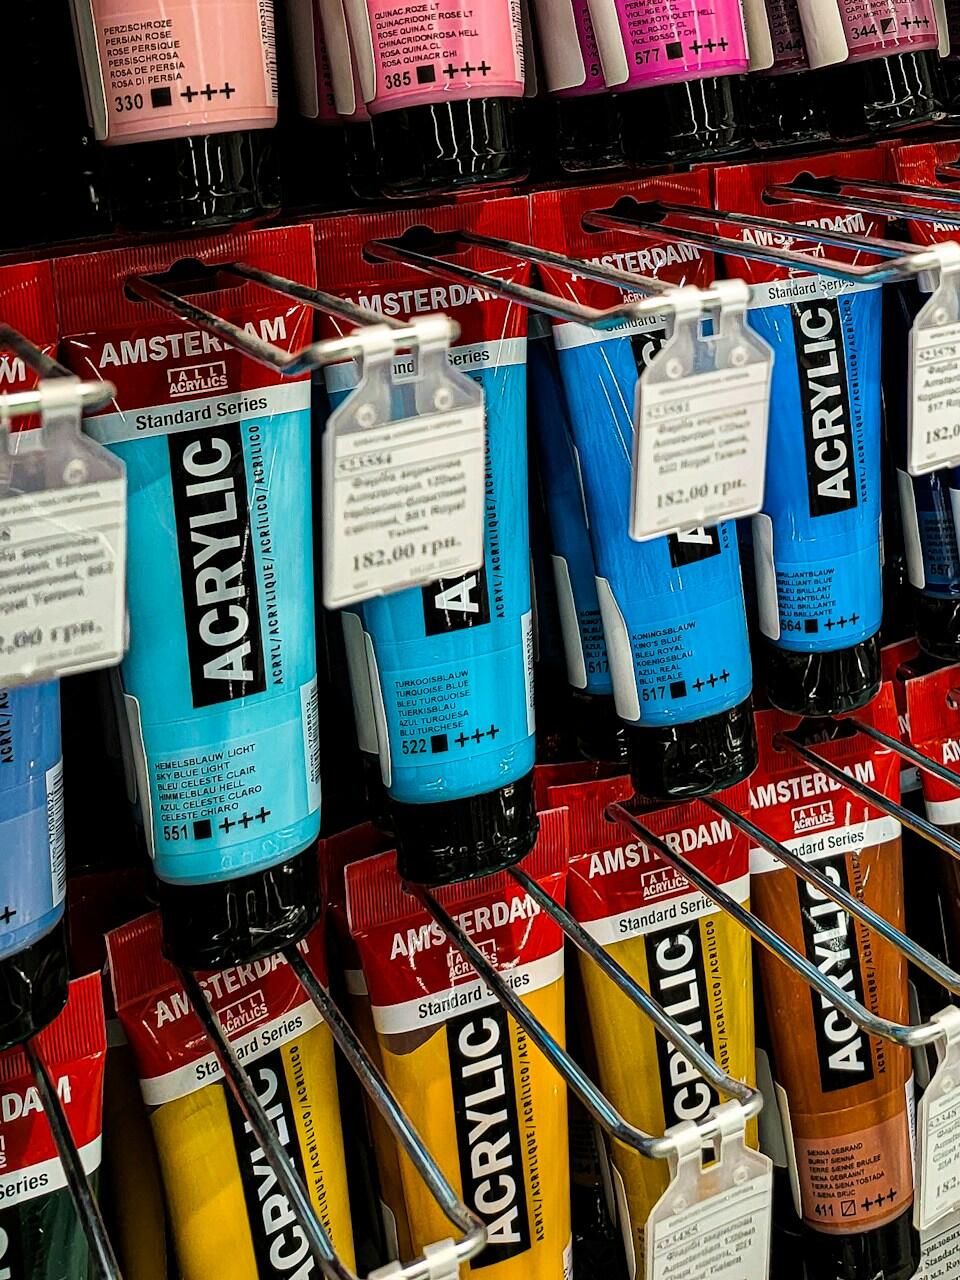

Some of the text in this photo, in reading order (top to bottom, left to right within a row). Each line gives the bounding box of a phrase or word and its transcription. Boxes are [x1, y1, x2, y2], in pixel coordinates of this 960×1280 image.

[376, 14, 436, 30] QUINACRIDONE
[439, 11, 461, 19] ROSE
[105, 30, 172, 45] PERSIAN ROSE
[379, 29, 479, 49] CHINACRIDONROSA HELL
[851, 24, 877, 40] 344
[107, 40, 180, 57] ROSE PERSIQUE
[381, 49, 400, 58] ROSA
[635, 48, 659, 65] 577
[108, 51, 179, 68] PERSISCHROSA
[382, 58, 401, 68] ROSA
[110, 61, 185, 79] ROSA DE PERSIA
[112, 72, 183, 89] ROSA DI PERSIA
[385, 71, 411, 90] 385
[114, 93, 144, 112] 330
[99, 316, 288, 368] AMSTERAM
[169, 374, 227, 394] ACRYLICS
[805, 306, 850, 501] ACRYLIC
[135, 395, 268, 431] Standard Series
[182, 437, 254, 684] ACRYLIC
[633, 621, 696, 640] KONINGSBLAUW
[661, 635, 683, 645] BLUE
[637, 650, 693, 667] KOENIGSBLAU
[658, 645, 684, 655] ROYAL
[660, 664, 681, 673] REAL
[395, 670, 469, 688] TURKOOISBLAUW
[640, 672, 683, 685] BLU REALE
[396, 680, 469, 697] TURQUOISE BLUE
[419, 690, 471, 704] TURQUOISE
[642, 686, 665, 701] 517
[398, 703, 456, 716] TUERKISBLAU
[421, 710, 469, 724] TURQUESA
[417, 721, 464, 734] TURCHESE
[402, 739, 426, 754] 522
[155, 744, 256, 769] HEMELSBLAUW LICHT
[158, 766, 256, 791] BLEU CELESTE CLAIR
[174, 769, 198, 778] BLUE
[201, 762, 230, 775] LIGHT
[159, 781, 245, 800] HIMMELBLAU HELL
[161, 785, 262, 811] AZUL CELESTE CLARO
[161, 803, 239, 821] CELESTE CHIARO
[164, 824, 188, 840] 551
[619, 904, 678, 934] Standard
[815, 1204, 833, 1216] 411
